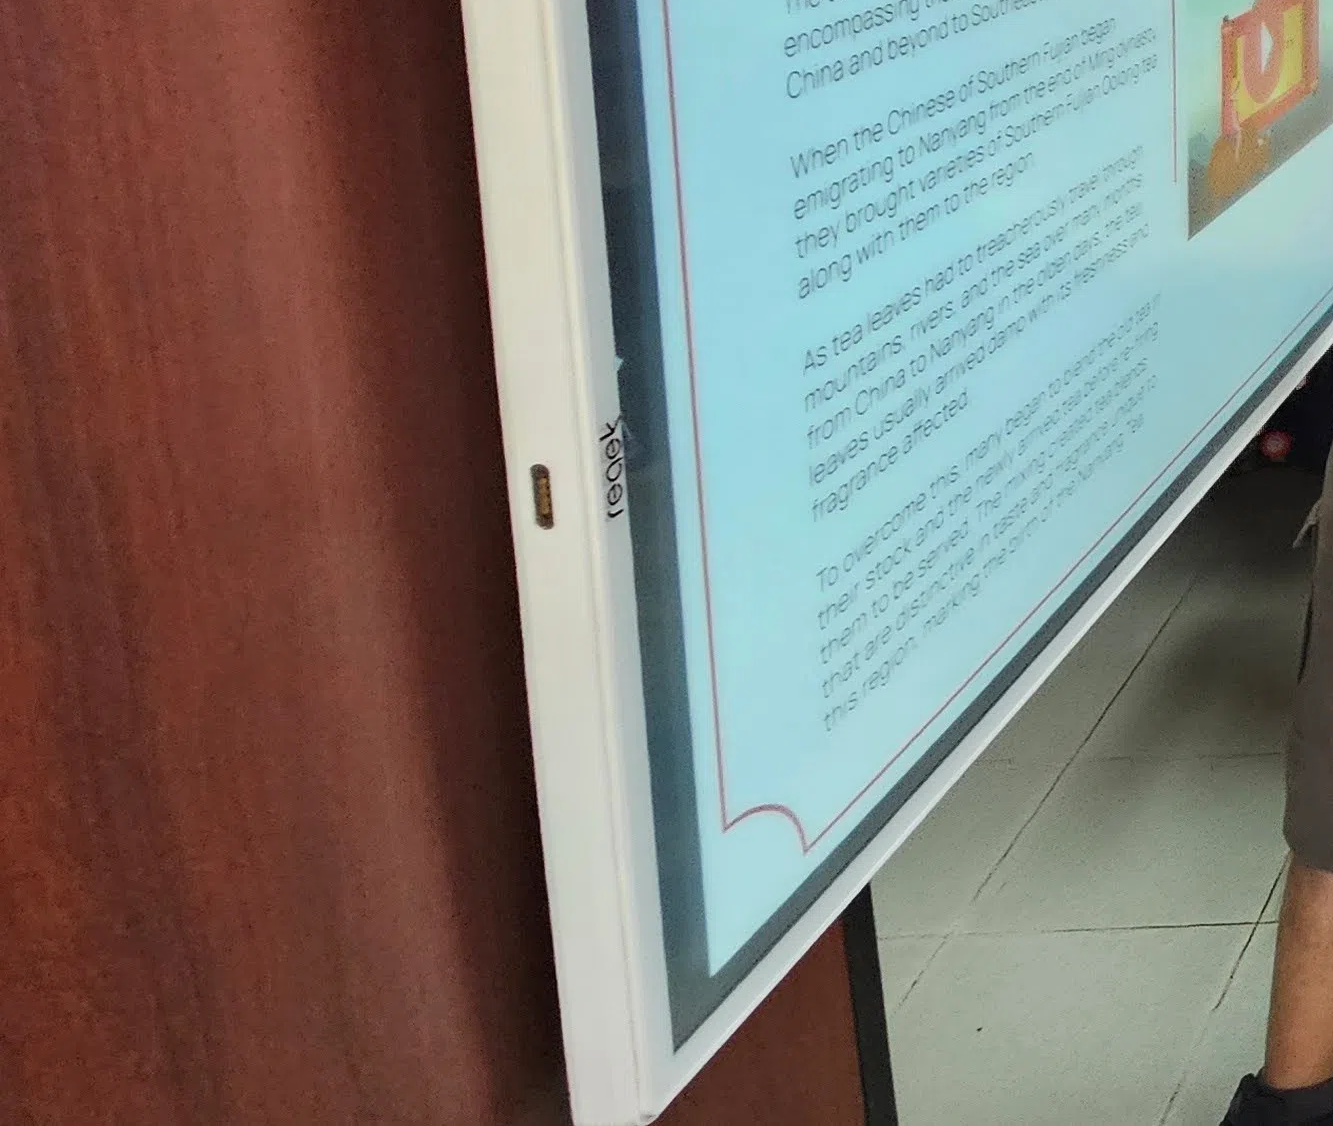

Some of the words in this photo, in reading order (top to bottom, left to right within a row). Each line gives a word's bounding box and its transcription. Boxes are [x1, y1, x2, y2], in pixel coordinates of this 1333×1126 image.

[785, 58, 845, 100] China
[848, 44, 884, 76] and
[886, 18, 950, 62] beyond
[951, 11, 970, 34] to
[789, 134, 849, 179] When
[852, 120, 884, 153] the
[886, 89, 956, 136] Chinese
[958, 78, 975, 103] of
[977, 49, 1042, 95] Southern
[794, 156, 895, 221] emigrating
[897, 142, 915, 168] to
[918, 108, 988, 155] Nanyang
[988, 92, 1021, 122] from
[795, 220, 841, 259] they
[845, 177, 916, 234] brought
[918, 144, 986, 192] varieties
[987, 134, 1002, 158] of
[1004, 102, 1065, 149] Southern
[798, 251, 853, 299] along
[856, 228, 895, 264] with
[897, 203, 942, 241] them
[942, 190, 961, 215] to
[963, 175, 989, 205] the
[960, 279, 990, 310] and
[991, 256, 1016, 289] the
[802, 343, 828, 376] As
[831, 321, 863, 357] tea
[866, 283, 922, 335] leaves
[923, 267, 954, 298] had
[955, 254, 973, 279] to
[805, 405, 853, 450] from
[854, 367, 907, 417] China
[909, 353, 927, 376] to
[929, 305, 996, 366] Nanyang
[808, 430, 870, 488] leaves
[872, 387, 932, 440] usually
[810, 444, 899, 523] fragrance
[815, 563, 840, 593] To
[841, 489, 929, 573] overcome
